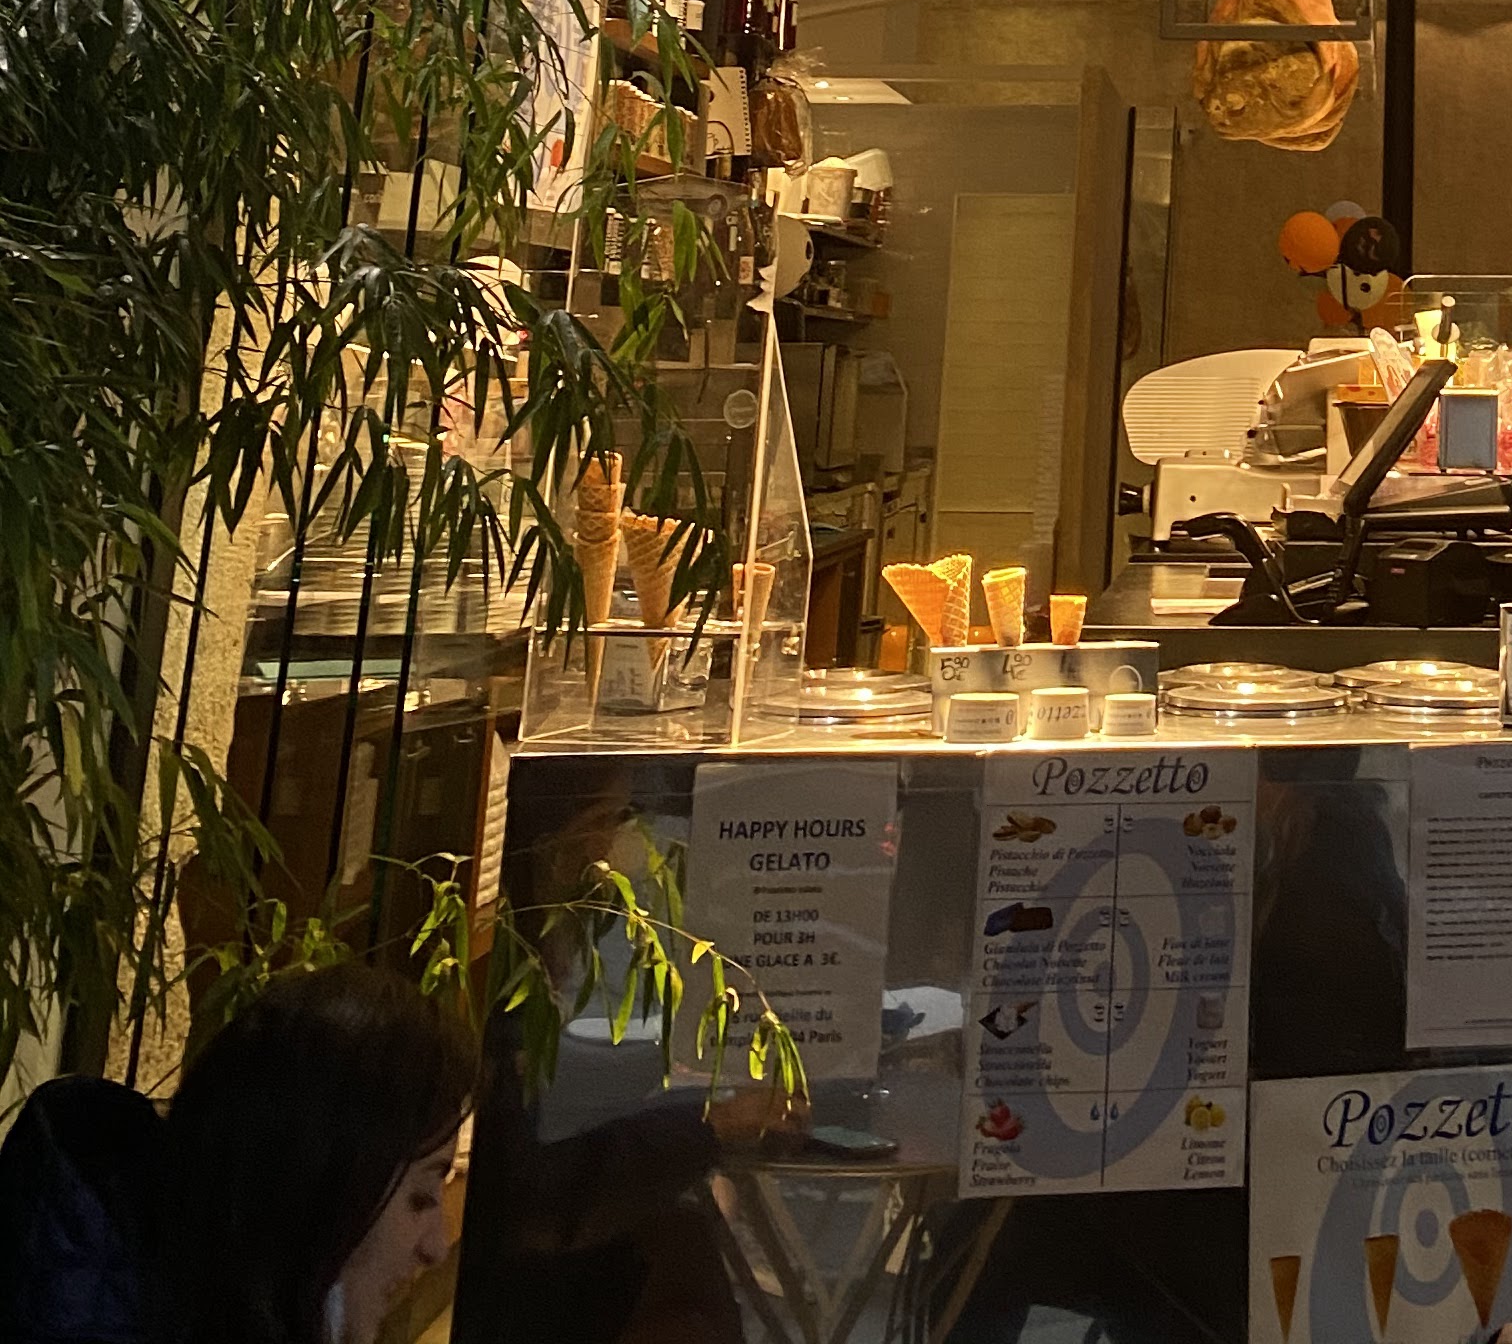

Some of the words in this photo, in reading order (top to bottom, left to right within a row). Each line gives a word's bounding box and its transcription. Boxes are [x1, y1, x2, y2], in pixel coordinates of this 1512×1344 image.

[1032, 755, 1209, 797] Pozzetto
[719, 820, 789, 840] HAPPY
[794, 818, 866, 838] HOURS
[749, 851, 831, 872] GELATO
[753, 910, 771, 923] DE
[753, 932, 793, 945] POUR
[756, 953, 799, 968] GLACE
[803, 953, 813, 966] A
